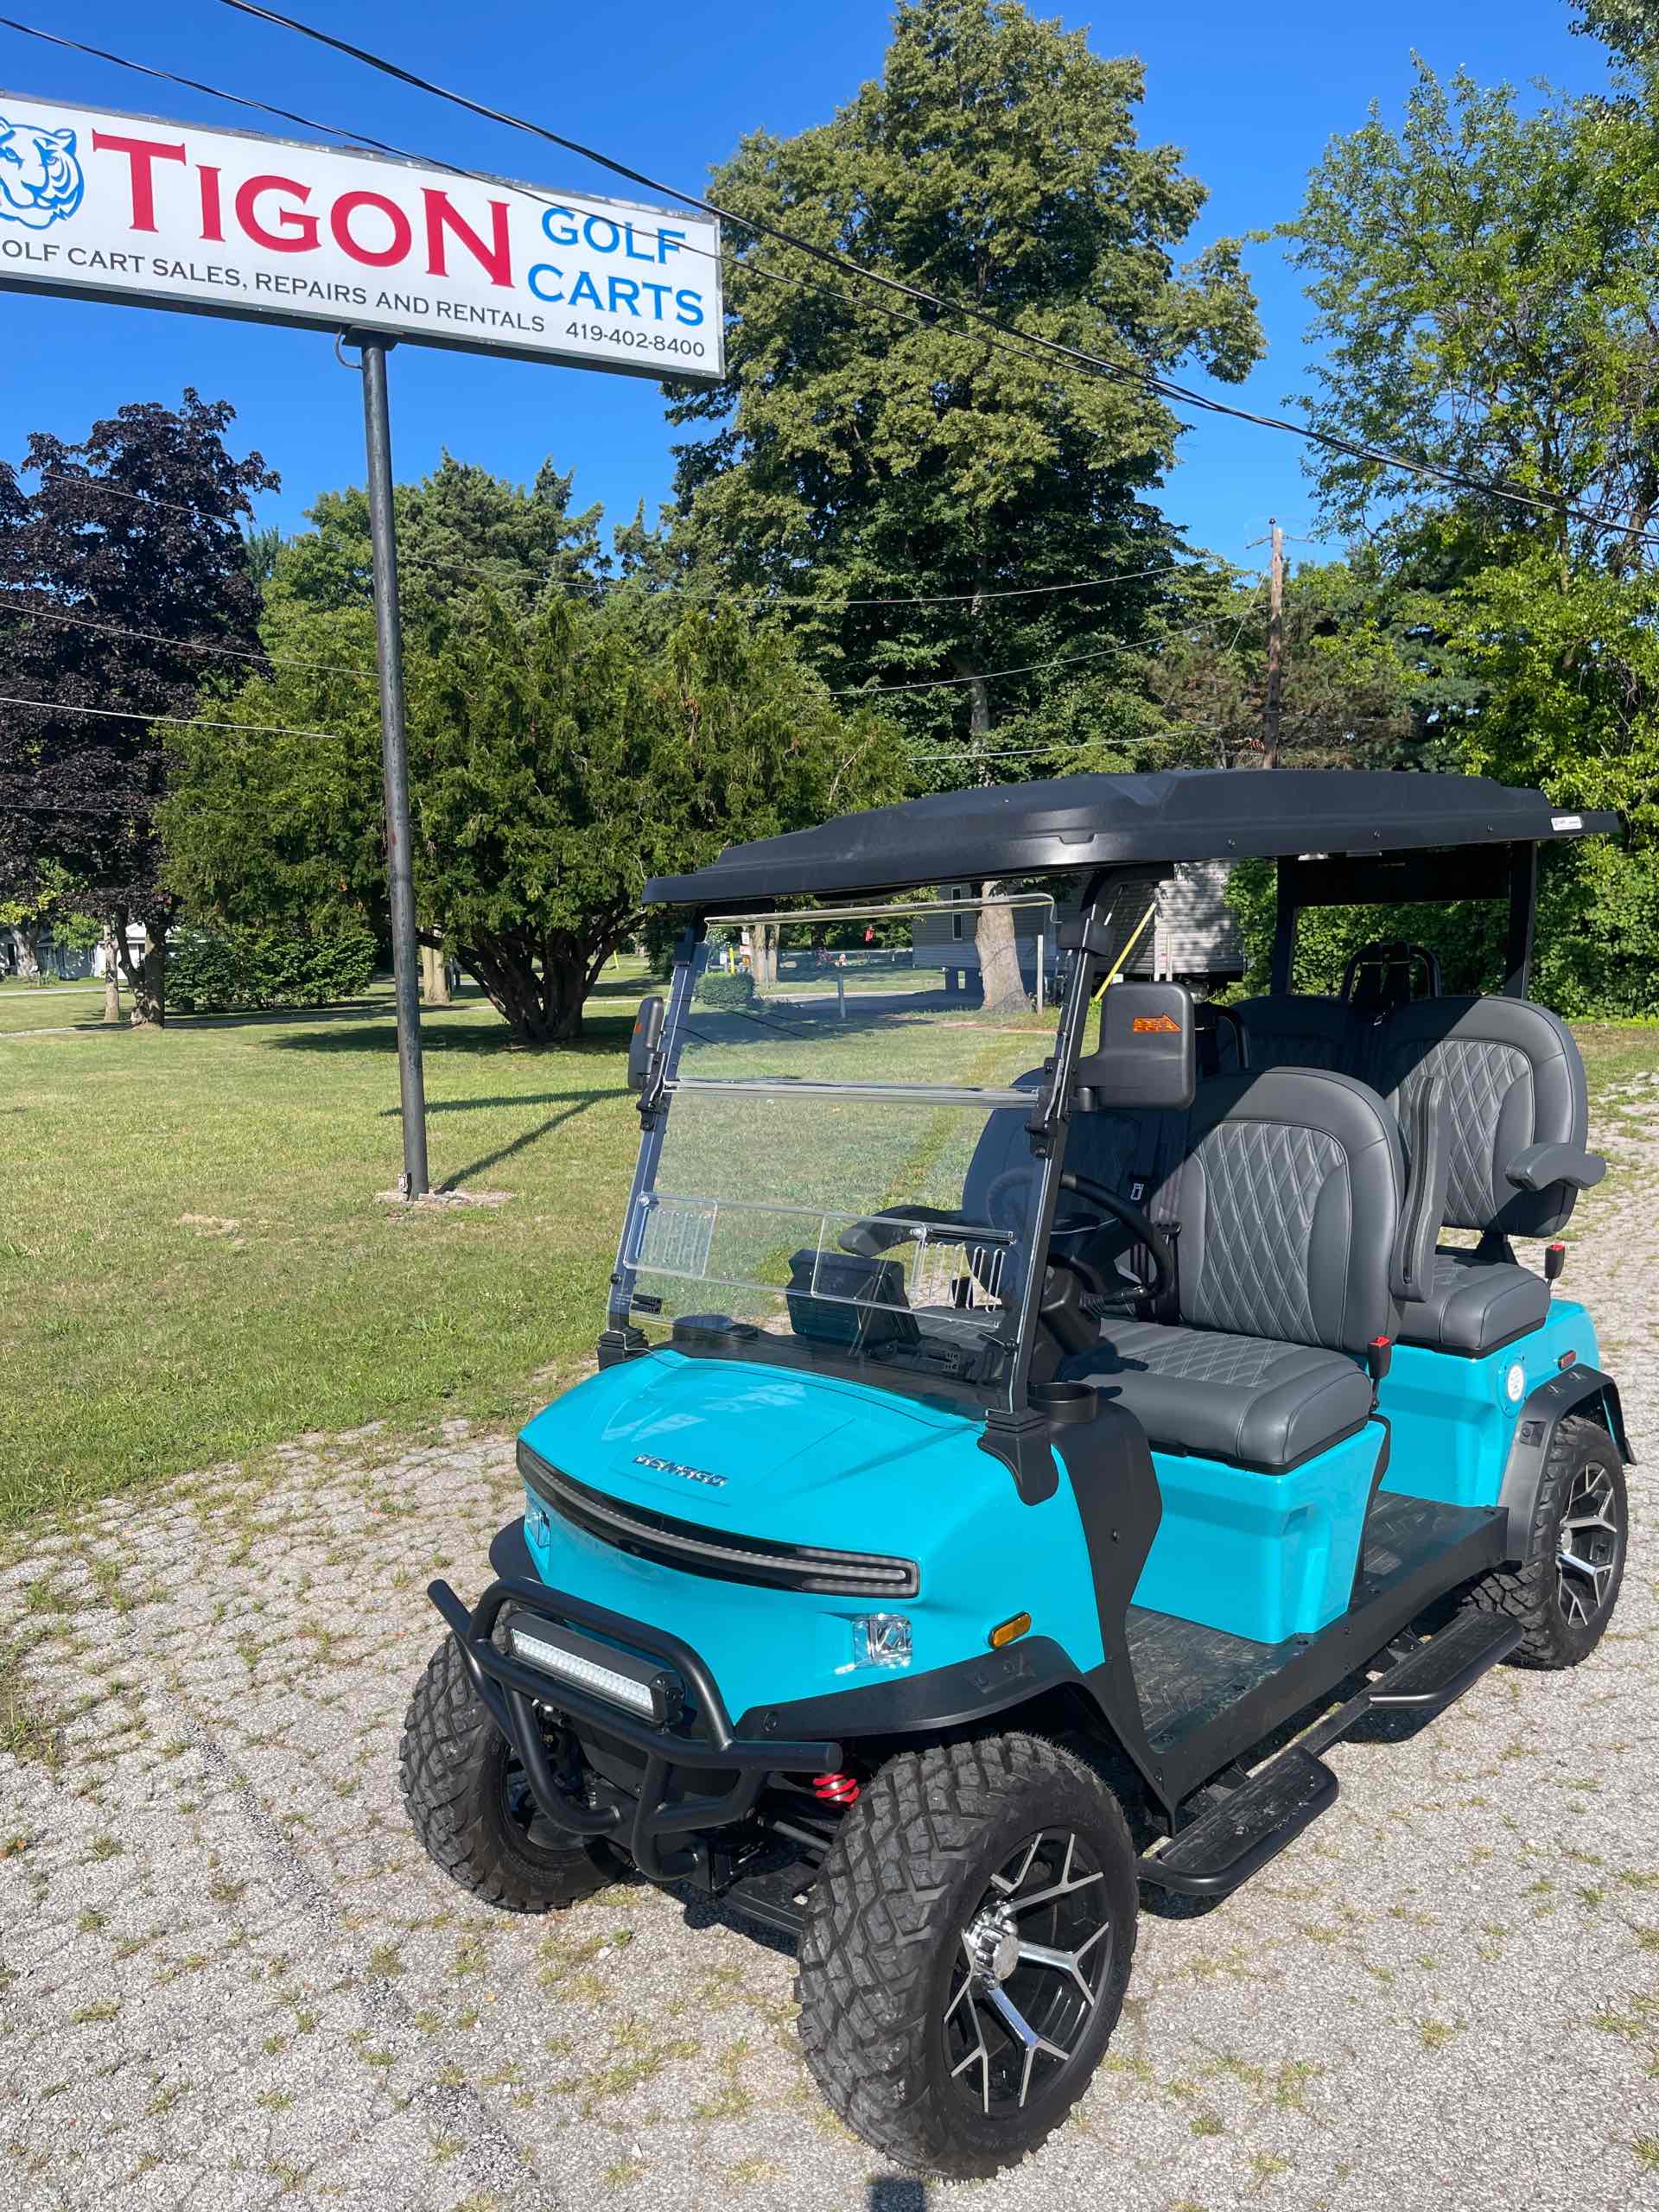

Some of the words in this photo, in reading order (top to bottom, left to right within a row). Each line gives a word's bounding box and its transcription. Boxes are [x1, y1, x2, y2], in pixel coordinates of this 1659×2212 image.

[92, 128, 515, 289] TIGON
[542, 206, 687, 264] GOLF
[1, 238, 60, 263] OLF
[67, 246, 146, 274] CART
[151, 257, 249, 291] SALES,
[254, 271, 368, 306] REPAIRS
[374, 290, 430, 315] AND
[435, 300, 545, 334] RENTALS
[527, 262, 705, 327] CARTS
[564, 321, 706, 359] 419-402-8400
